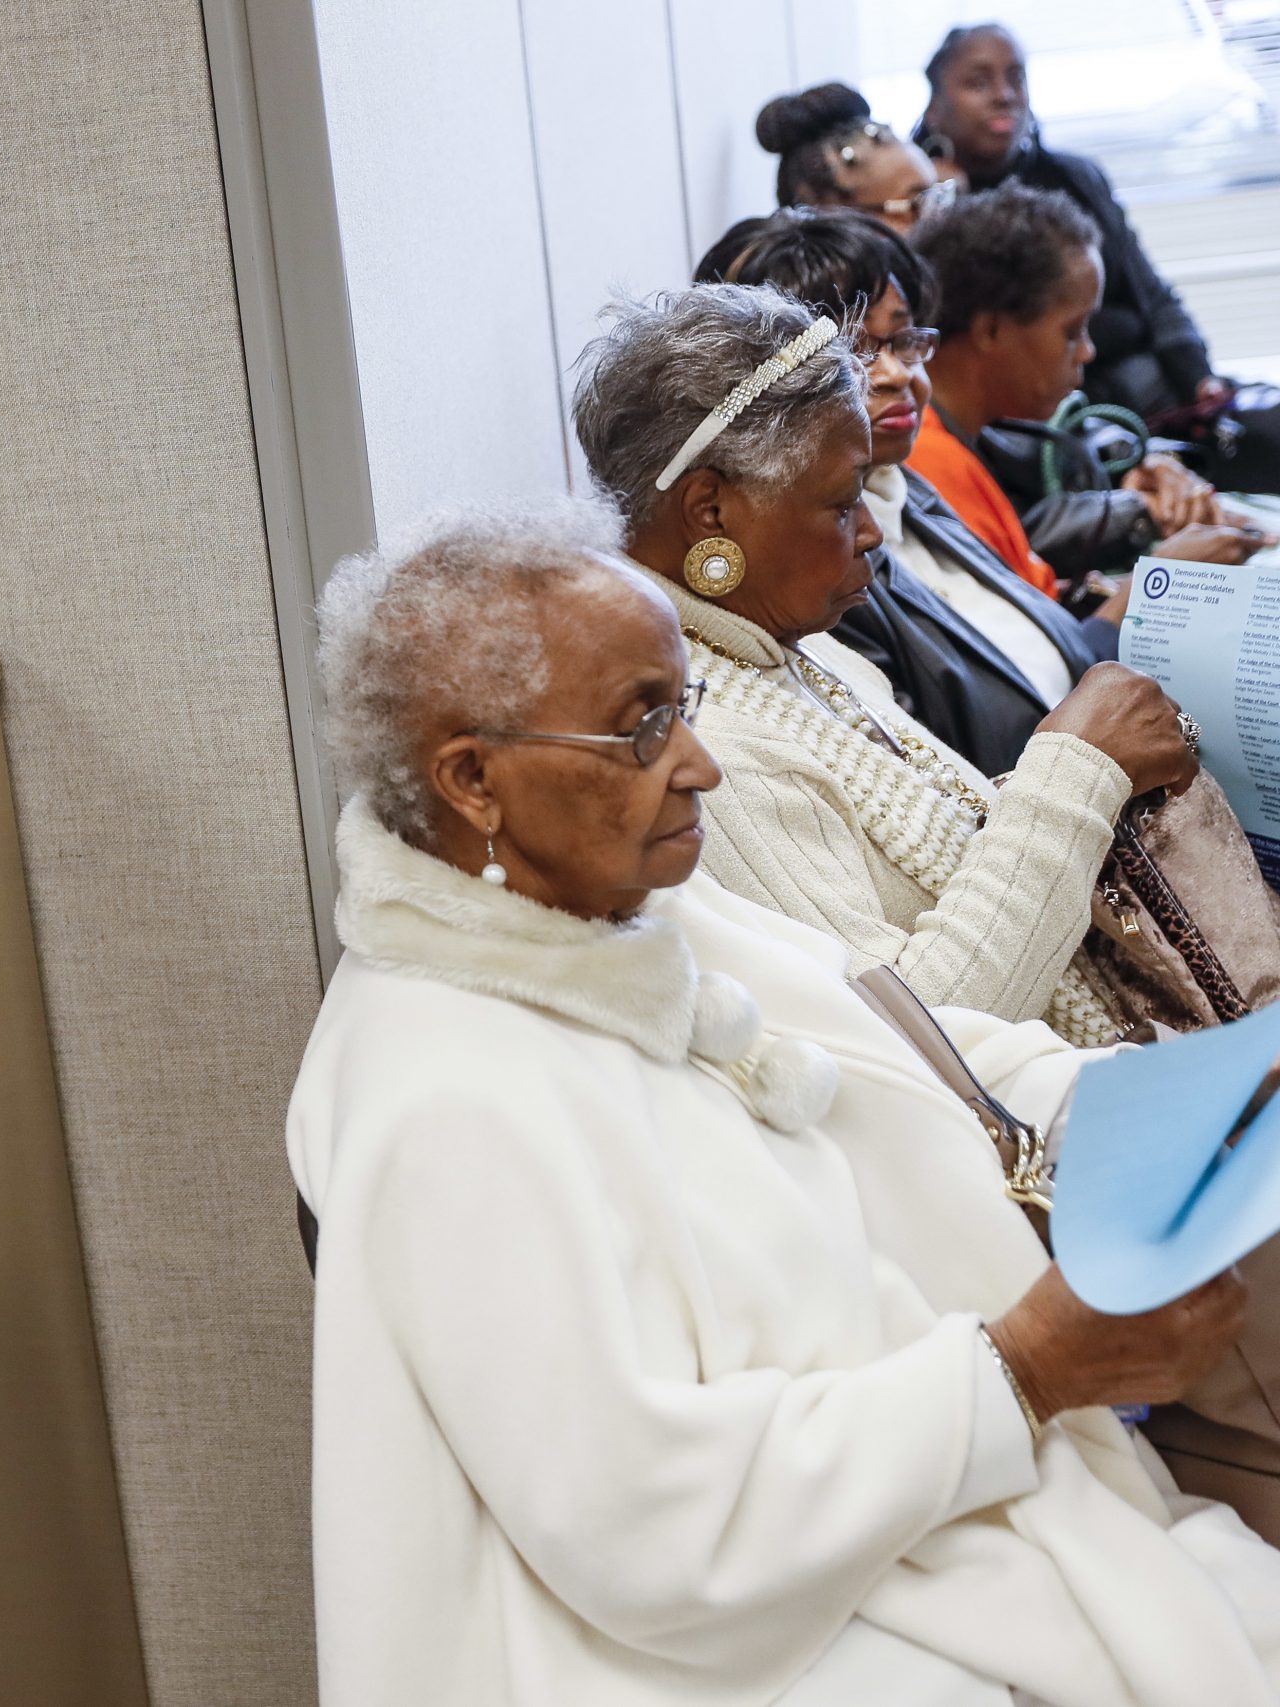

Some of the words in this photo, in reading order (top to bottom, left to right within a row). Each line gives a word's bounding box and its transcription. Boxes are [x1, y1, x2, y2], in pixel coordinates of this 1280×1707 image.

[1174, 568, 1209, 579] Democratic
[1210, 572, 1227, 581] Party
[1171, 580, 1200, 590] Endorsed
[1200, 583, 1235, 594] Candidates
[1180, 593, 1199, 602] Issues
[1204, 596, 1220, 604] 2018
